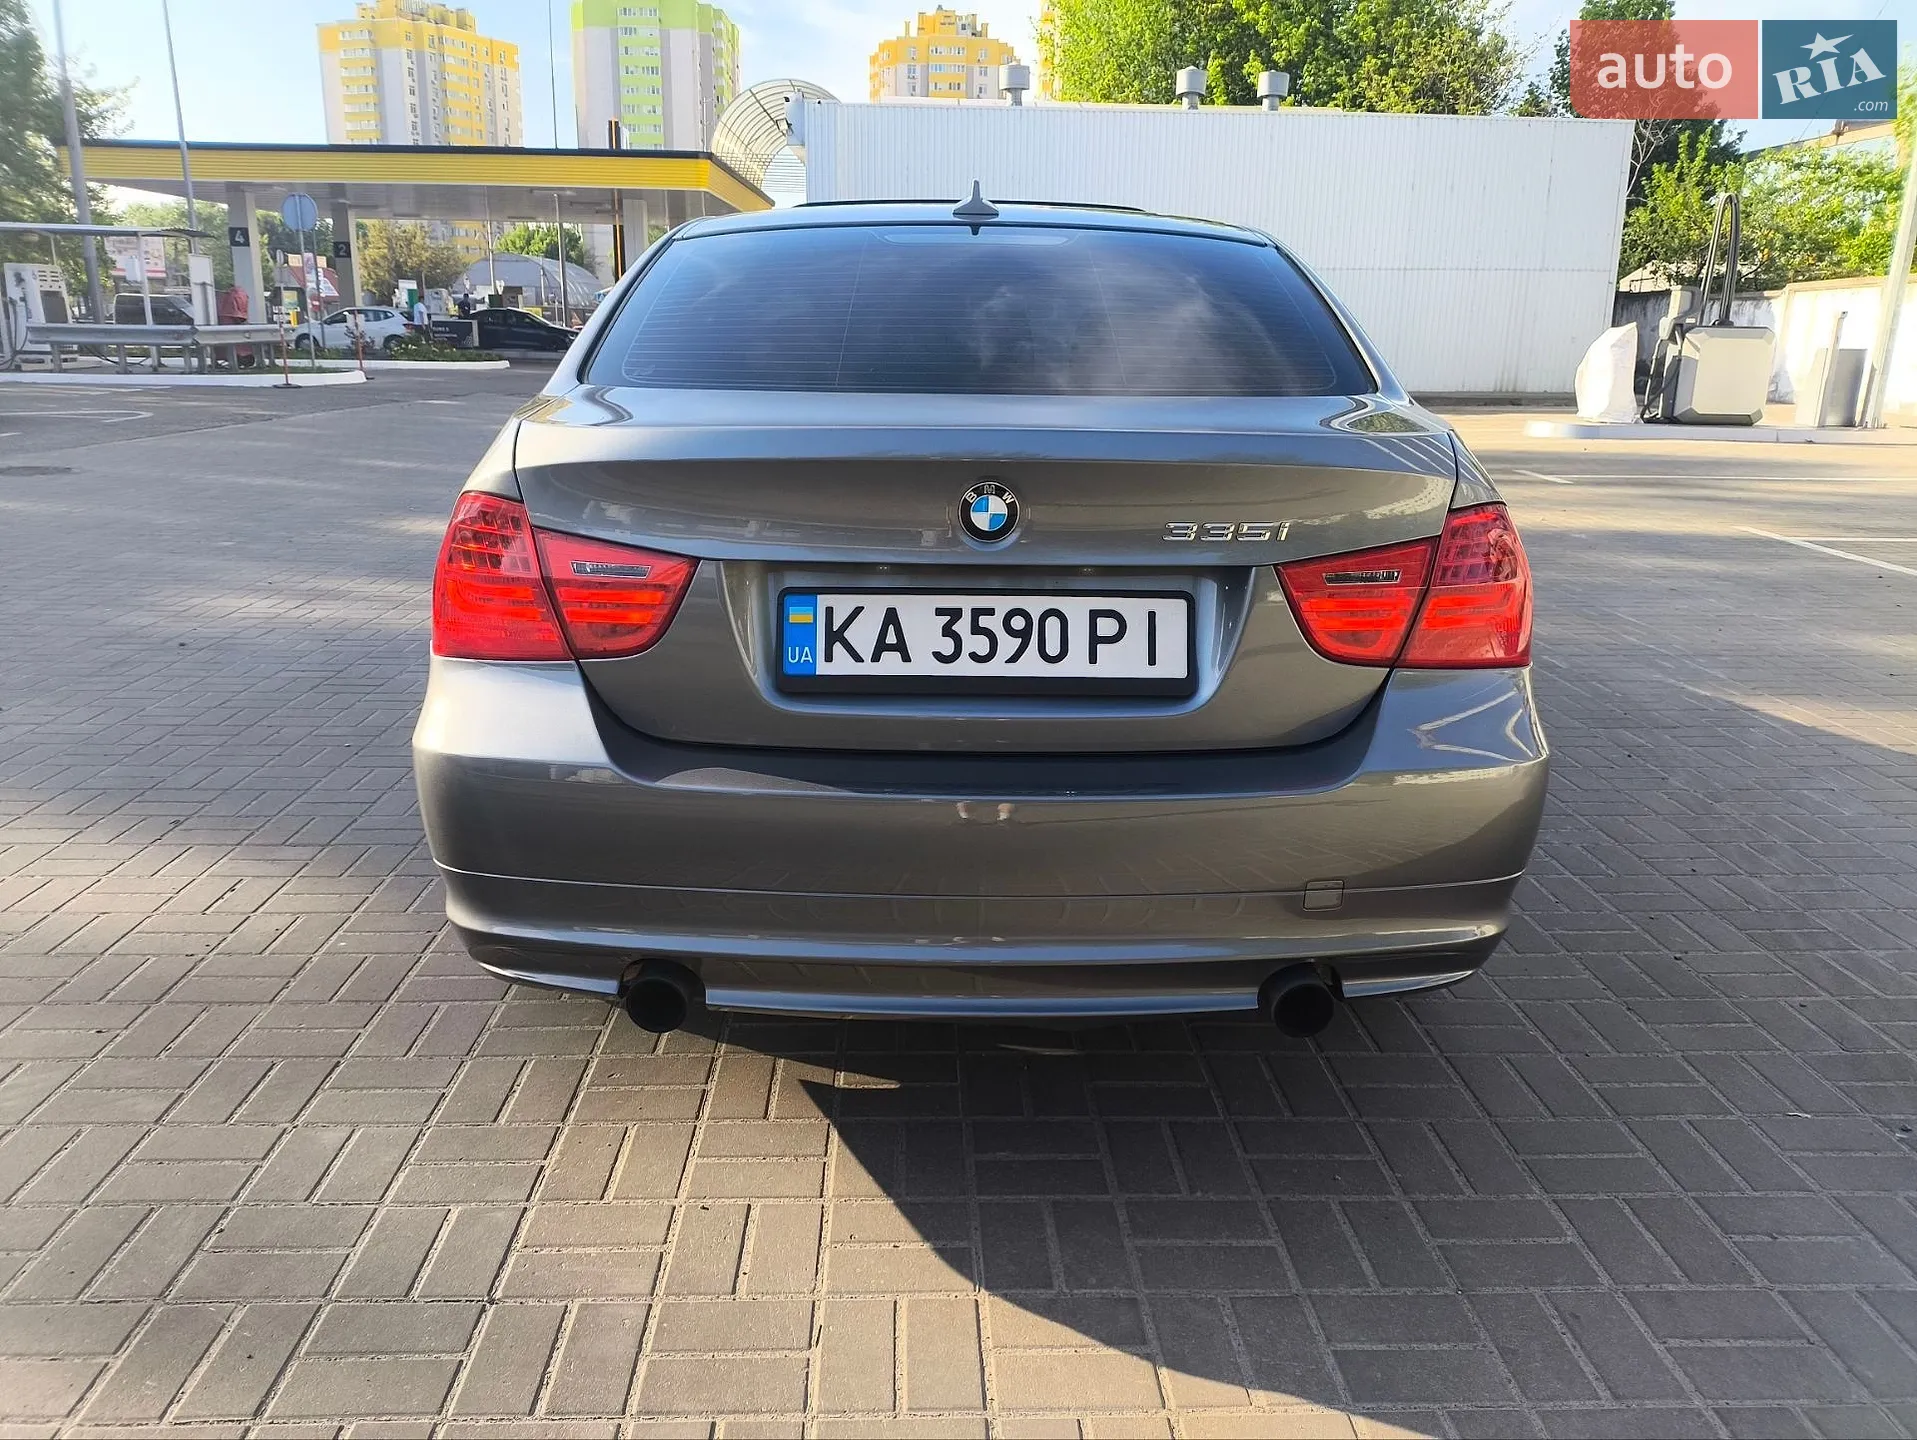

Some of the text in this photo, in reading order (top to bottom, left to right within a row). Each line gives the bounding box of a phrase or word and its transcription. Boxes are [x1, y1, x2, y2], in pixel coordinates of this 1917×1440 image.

[235, 230, 244, 243] 4
[338, 244, 346, 256] 2
[965, 484, 1015, 504] BMW
[1162, 521, 1291, 543] 335i
[823, 605, 1157, 667] KA 3590 PI
[787, 646, 814, 665] UA
